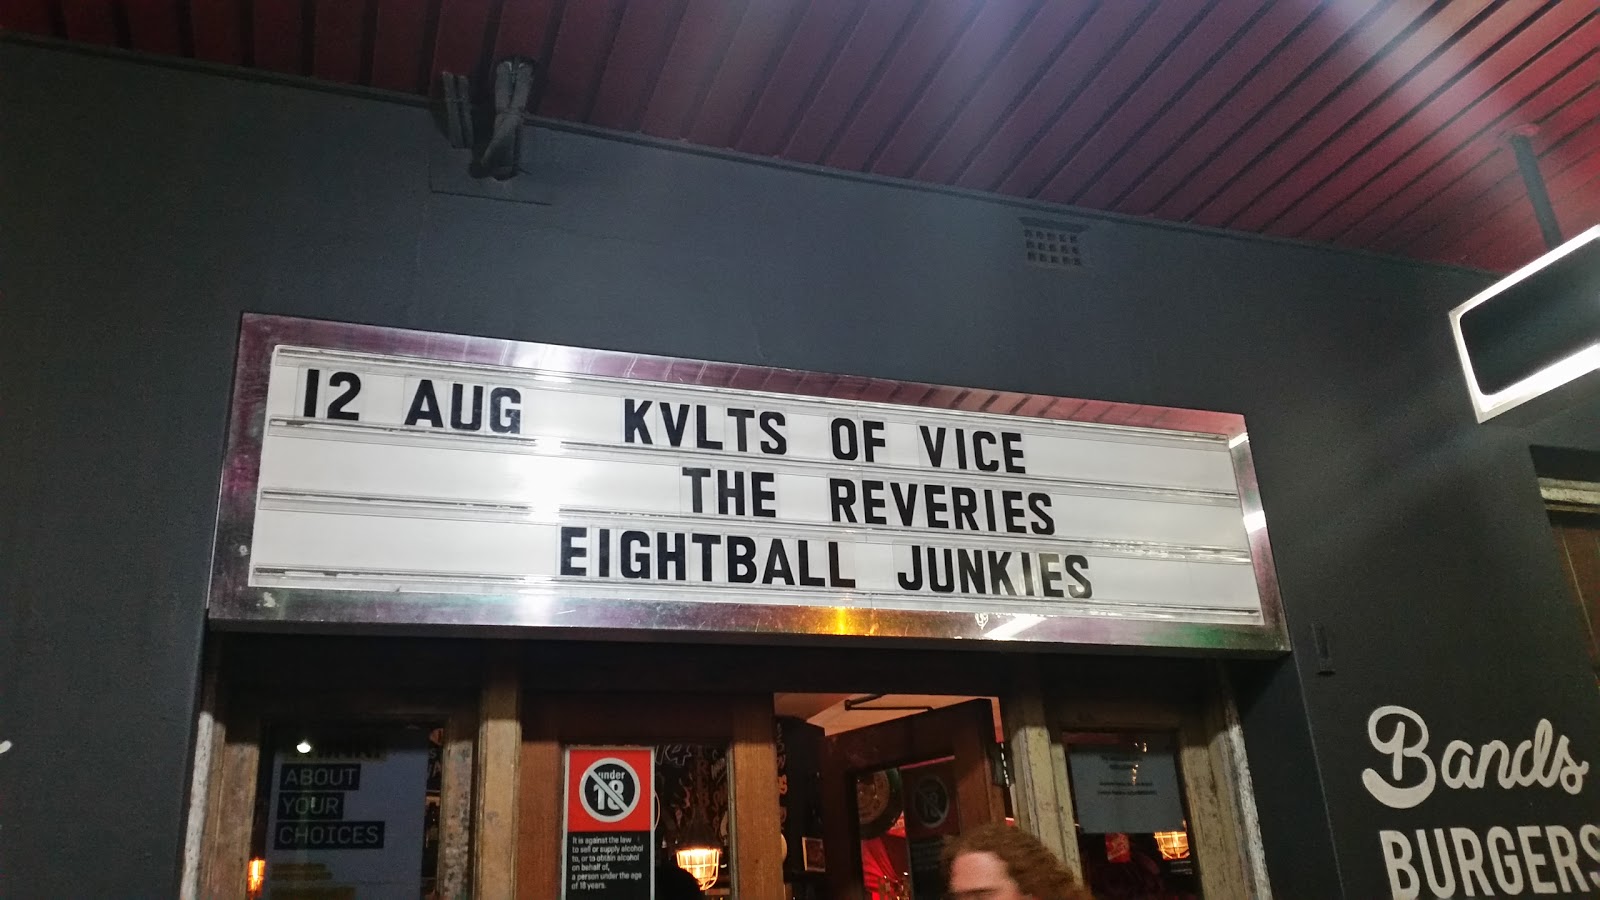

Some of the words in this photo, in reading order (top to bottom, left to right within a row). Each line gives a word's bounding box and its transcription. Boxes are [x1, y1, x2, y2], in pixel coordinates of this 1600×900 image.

[303, 369, 361, 421] 12
[404, 379, 521, 434] AUG
[624, 399, 786, 455] KVLTS
[831, 418, 886, 462] OF
[920, 425, 1026, 474] VICE
[682, 467, 776, 517] THE
[830, 478, 1055, 535] REVERIES
[561, 527, 856, 588] EIGHTBALL
[898, 545, 1092, 598] JUNKIES
[1362, 705, 1589, 809] Bands
[284, 768, 357, 786] ABOUT
[598, 769, 626, 781] under
[593, 780, 625, 811] 18
[282, 797, 339, 815] YOUR
[279, 826, 379, 844] CHOICES
[578, 836, 584, 844] is
[585, 836, 608, 846] against
[608, 836, 619, 844] the
[620, 836, 632, 844] law
[572, 846, 580, 854] to
[580, 845, 591, 854] sell
[600, 845, 620, 855] supply
[621, 844, 644, 852] alcohol
[596, 854, 616, 862] obtain
[617, 853, 640, 862] alcohol
[572, 864, 580, 872] on
[576, 873, 600, 882] person
[600, 872, 618, 880] under
[619, 872, 630, 880] the
[630, 872, 642, 881] age
[571, 882, 578, 890] of
[580, 881, 586, 890] 18
